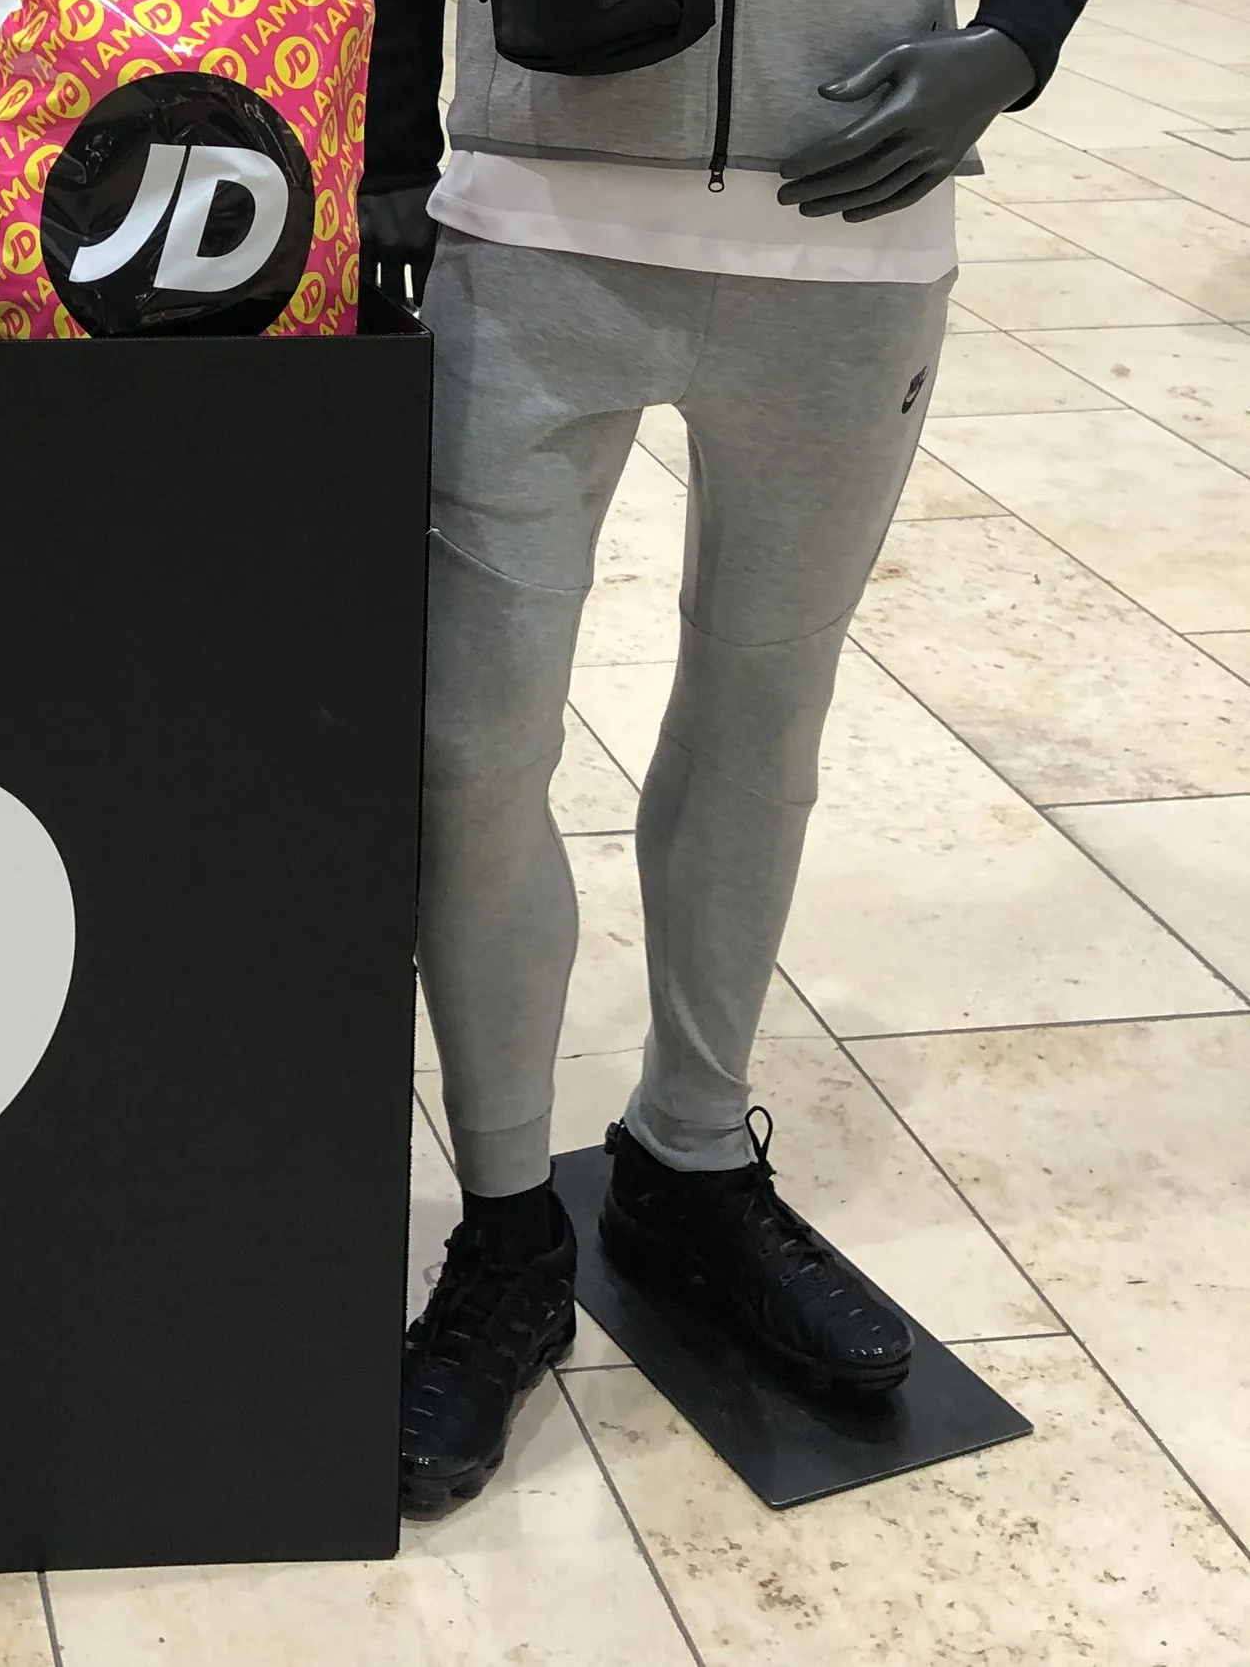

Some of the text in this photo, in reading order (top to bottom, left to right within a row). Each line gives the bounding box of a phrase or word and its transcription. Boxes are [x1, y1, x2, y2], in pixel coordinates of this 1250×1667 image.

[143, 2, 172, 31] JD
[81, 19, 146, 79] I AM
[241, 33, 261, 56] I
[284, 42, 312, 84] JD
[57, 78, 82, 115] JD
[0, 105, 56, 160] I AM
[68, 143, 290, 293] JD
[321, 197, 335, 237] JD
[10, 229, 36, 269] JD
[299, 279, 323, 320] JD
